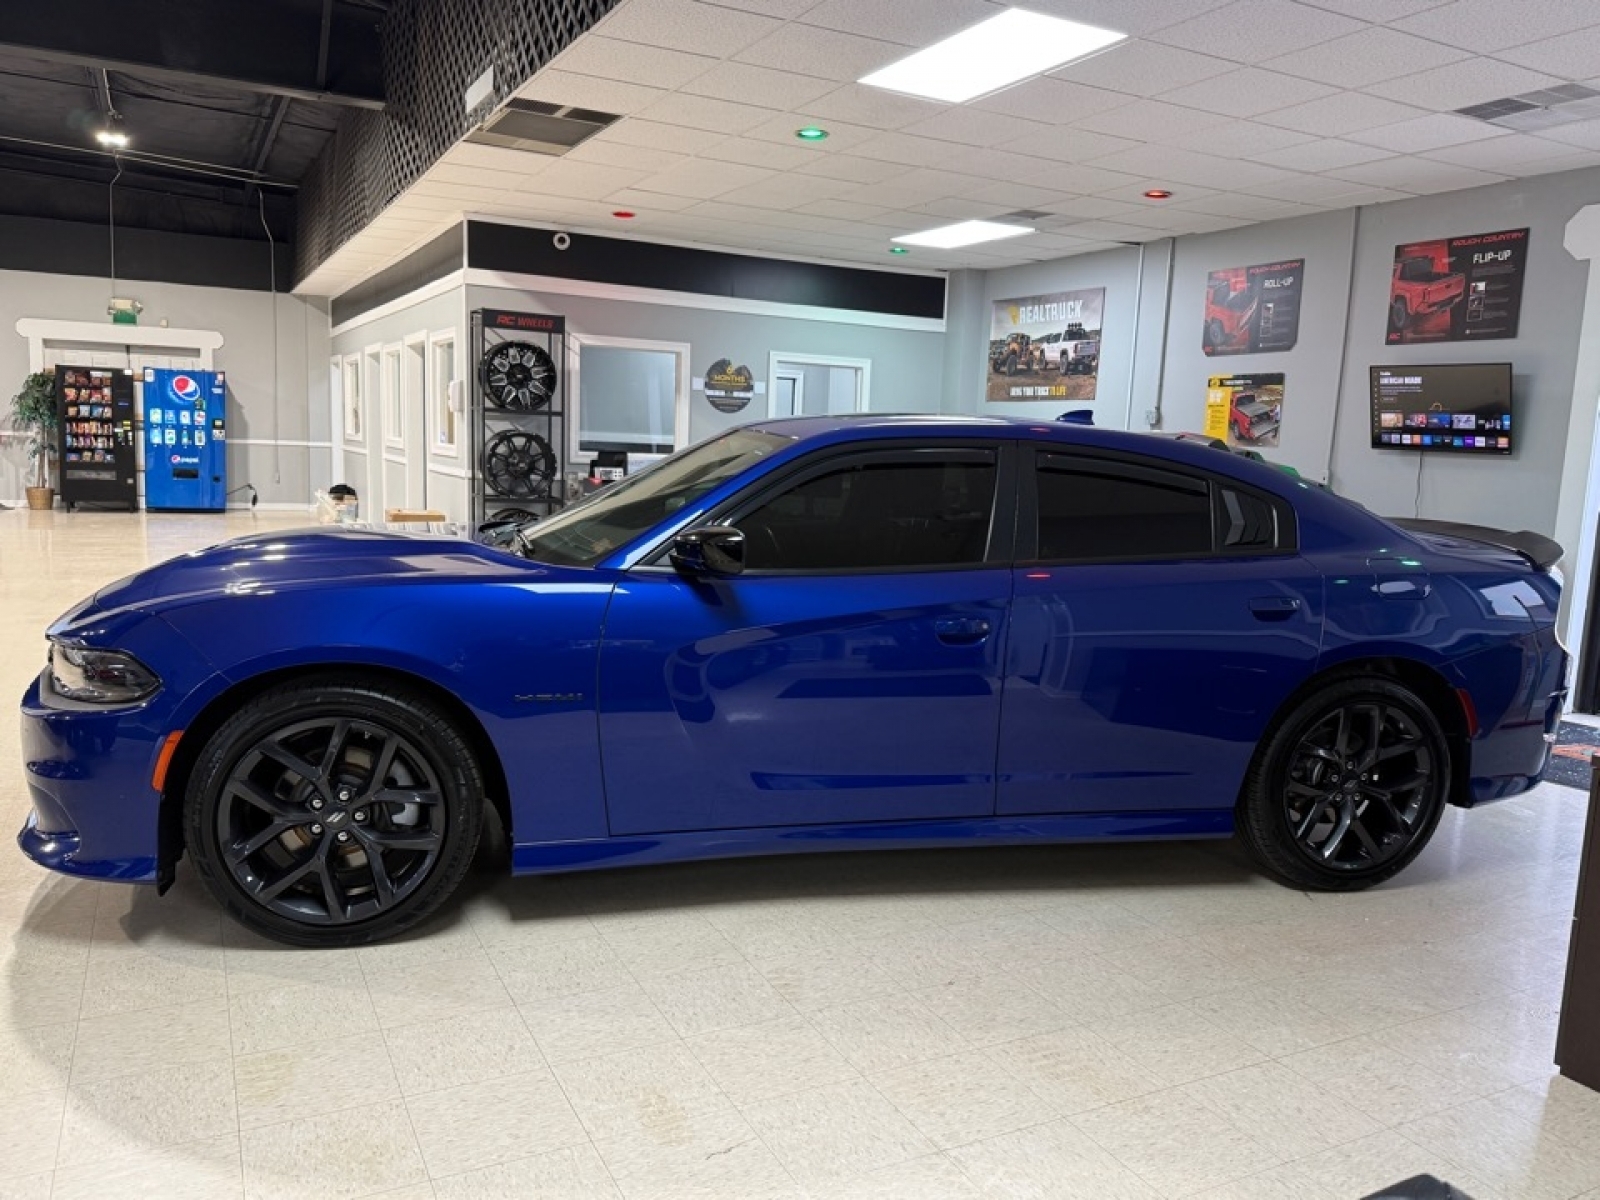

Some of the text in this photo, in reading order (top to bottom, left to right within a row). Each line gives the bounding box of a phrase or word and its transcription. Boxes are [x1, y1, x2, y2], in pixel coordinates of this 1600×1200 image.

[1473, 250, 1512, 264] FLIP-UP
[1264, 277, 1293, 288] ROLL-UP
[1019, 300, 1082, 323] REALTRUCK
[496, 314, 555, 329] RC WHEELS
[714, 374, 746, 383] MONTHS
